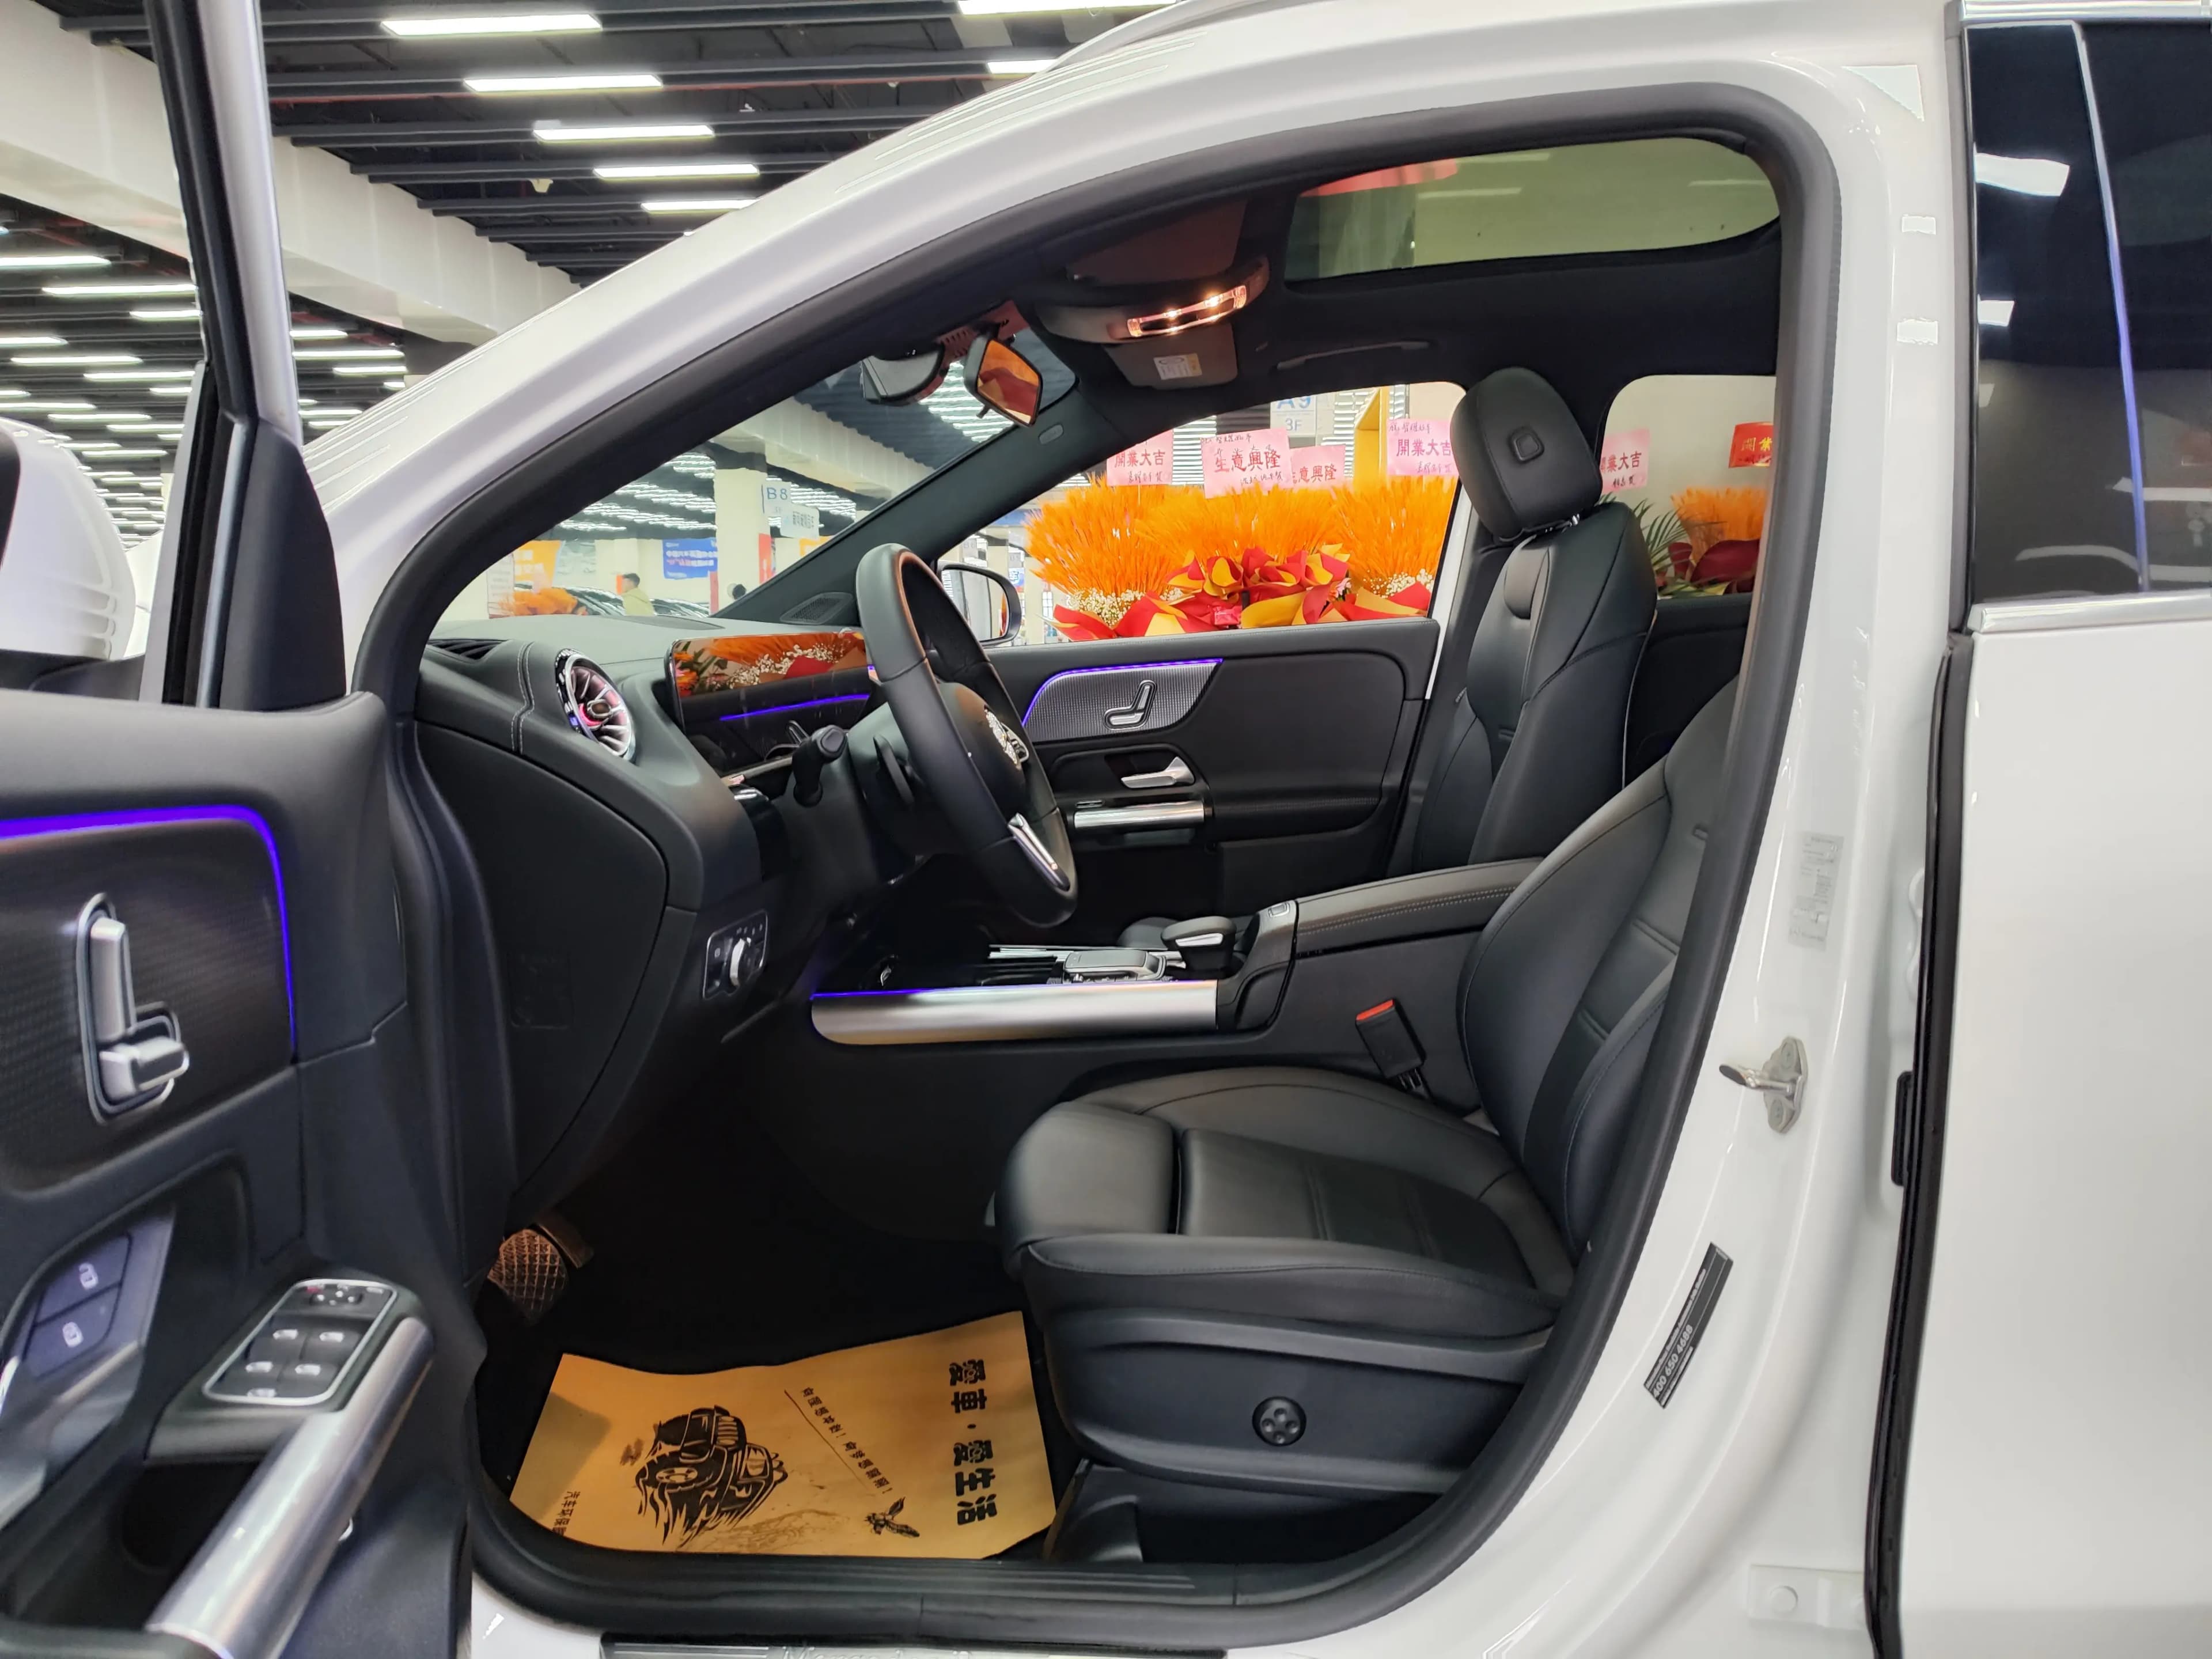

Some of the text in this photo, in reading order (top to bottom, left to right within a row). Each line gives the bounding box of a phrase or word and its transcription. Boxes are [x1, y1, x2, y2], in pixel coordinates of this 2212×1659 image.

[1285, 418, 1302, 431] 3F
[1396, 438, 1451, 457] 開業大吉
[1115, 449, 1165, 468] 開業大吉
[1214, 449, 1281, 473] 生意興隆
[766, 487, 787, 500] B8
[1653, 1375, 1667, 1399] 400
[1665, 1353, 1679, 1377] 650
[1676, 1324, 1694, 1354] 4688
